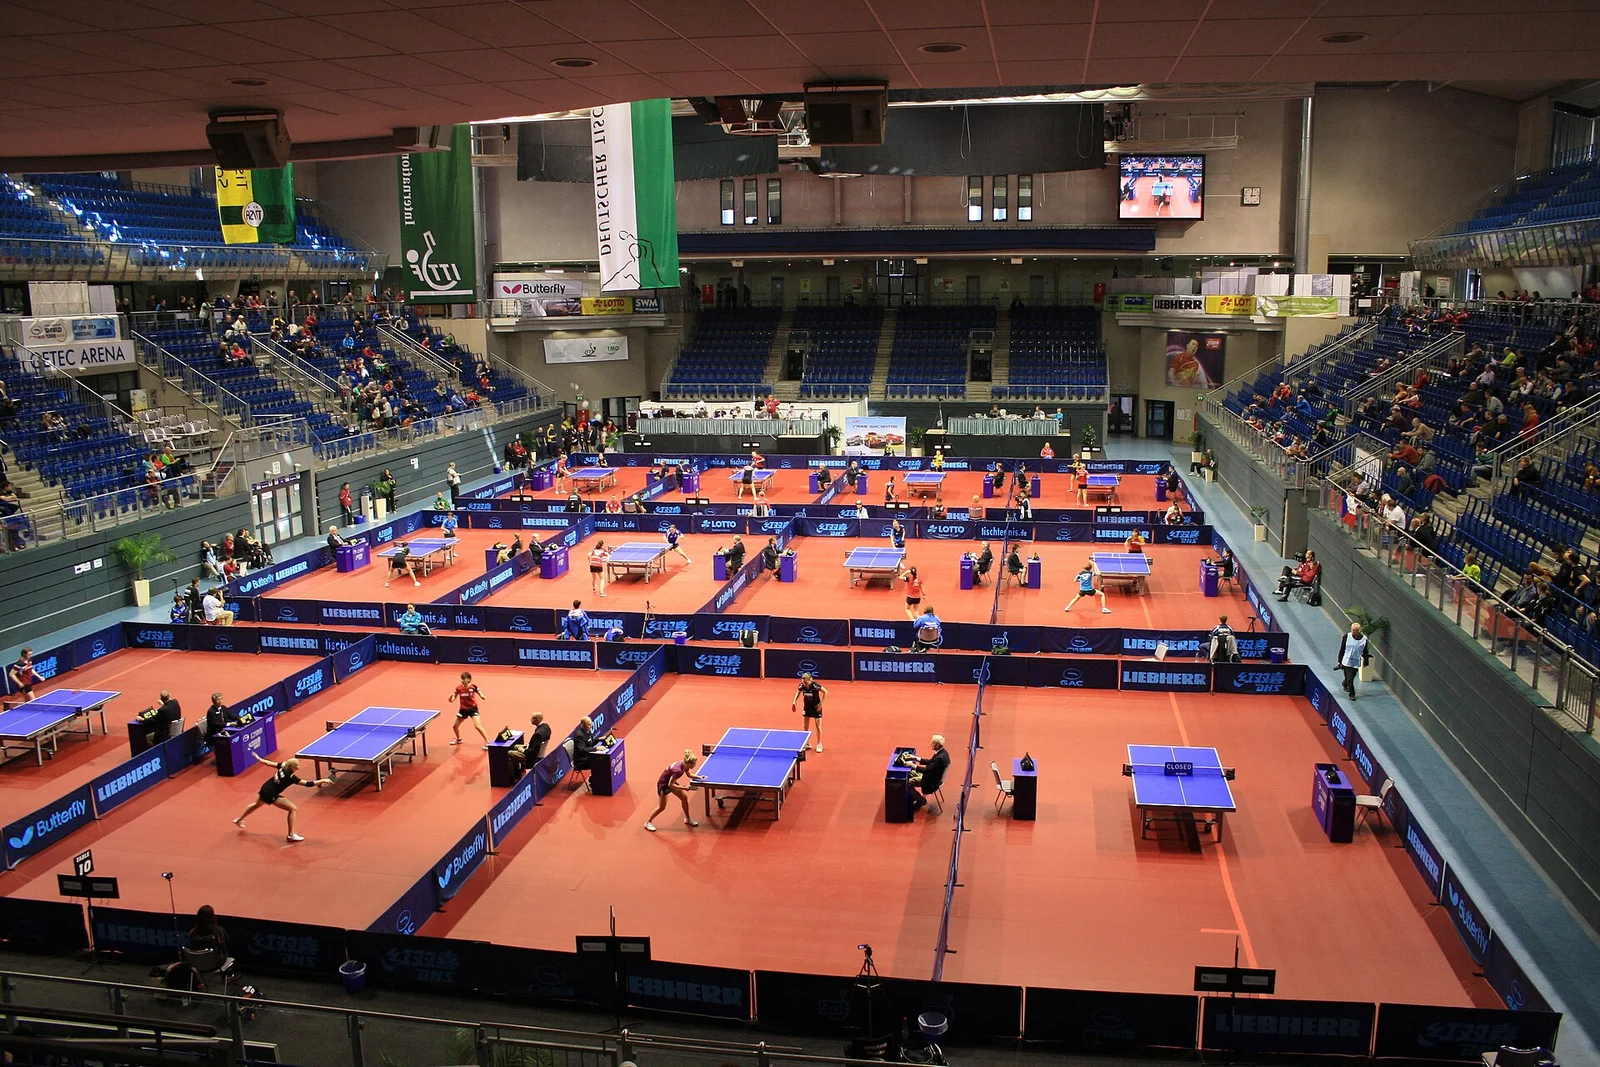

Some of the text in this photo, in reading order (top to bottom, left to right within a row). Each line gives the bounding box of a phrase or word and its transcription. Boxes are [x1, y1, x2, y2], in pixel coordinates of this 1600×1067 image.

[522, 284, 565, 294] Butterfly
[603, 299, 624, 307] LOTTO
[635, 298, 658, 306] SWM
[1155, 299, 1202, 310] LIEBHERR
[81, 346, 126, 364] ARENA
[523, 518, 569, 526] LIEBHERR
[711, 520, 736, 528] LOTTO
[938, 525, 964, 533] LOTTO
[276, 561, 307, 580] LIEBHERR
[252, 572, 274, 589] Butterfly
[322, 608, 380, 619] LIEBHERR
[1123, 638, 1200, 650] LIEBHERR
[92, 648, 106, 658] GAC
[519, 648, 591, 662] LIEBHERR
[860, 660, 935, 673] LIEBHERR
[1123, 670, 1206, 685] LIEBHERR
[1359, 747, 1373, 777] LOTTO
[98, 757, 161, 801] LIEBHERR
[493, 784, 532, 833] LIEBHERR
[36, 798, 86, 837] Butterfly
[76, 851, 90, 862] TABLE
[453, 833, 484, 875] Butterfly
[1407, 824, 1439, 884] LIEBHERR
[78, 860, 91, 875] 10
[1458, 897, 1488, 954] Butterfly
[416, 969, 457, 983] DHS
[1215, 1013, 1361, 1037] LIEBHERR
